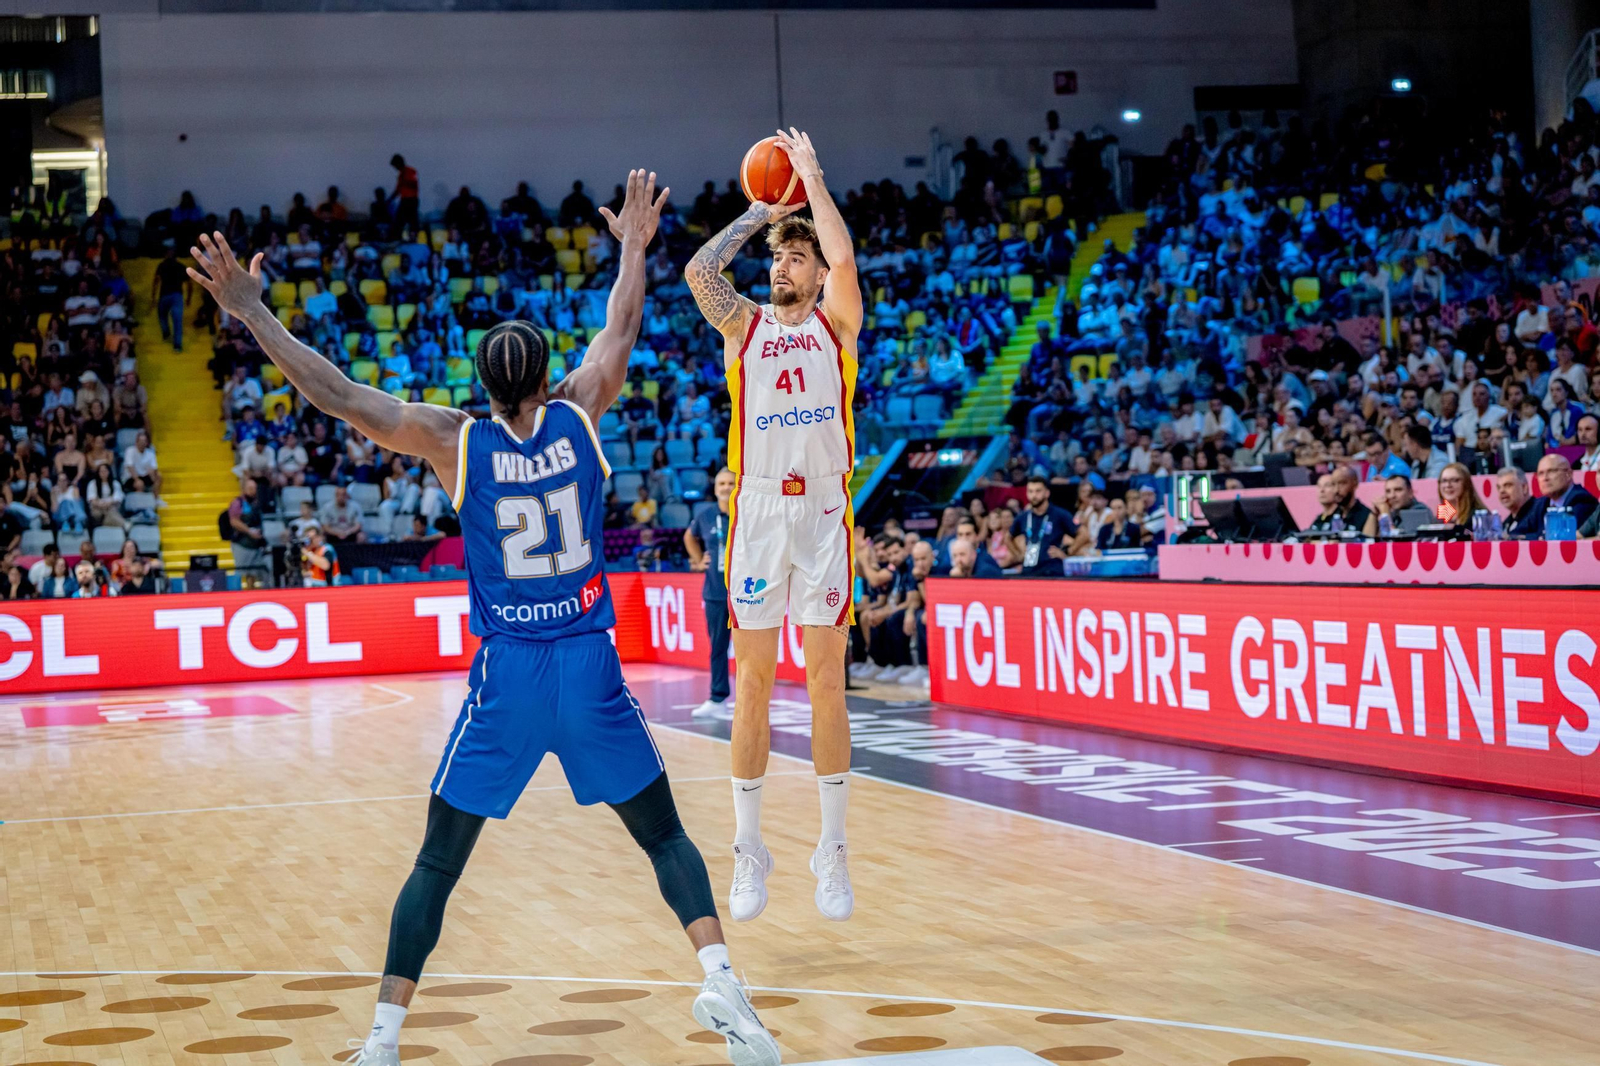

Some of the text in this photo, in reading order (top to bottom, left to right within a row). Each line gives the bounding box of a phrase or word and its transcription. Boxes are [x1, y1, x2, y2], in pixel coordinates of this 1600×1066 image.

[775, 367, 806, 395] 41
[756, 406, 836, 430] endesa
[492, 437, 577, 483] WILLIS
[495, 482, 592, 579] 21
[154, 601, 363, 670] TCL
[645, 585, 694, 652] TCL
[935, 601, 1600, 757] TCL INSPIRE GREATNES
